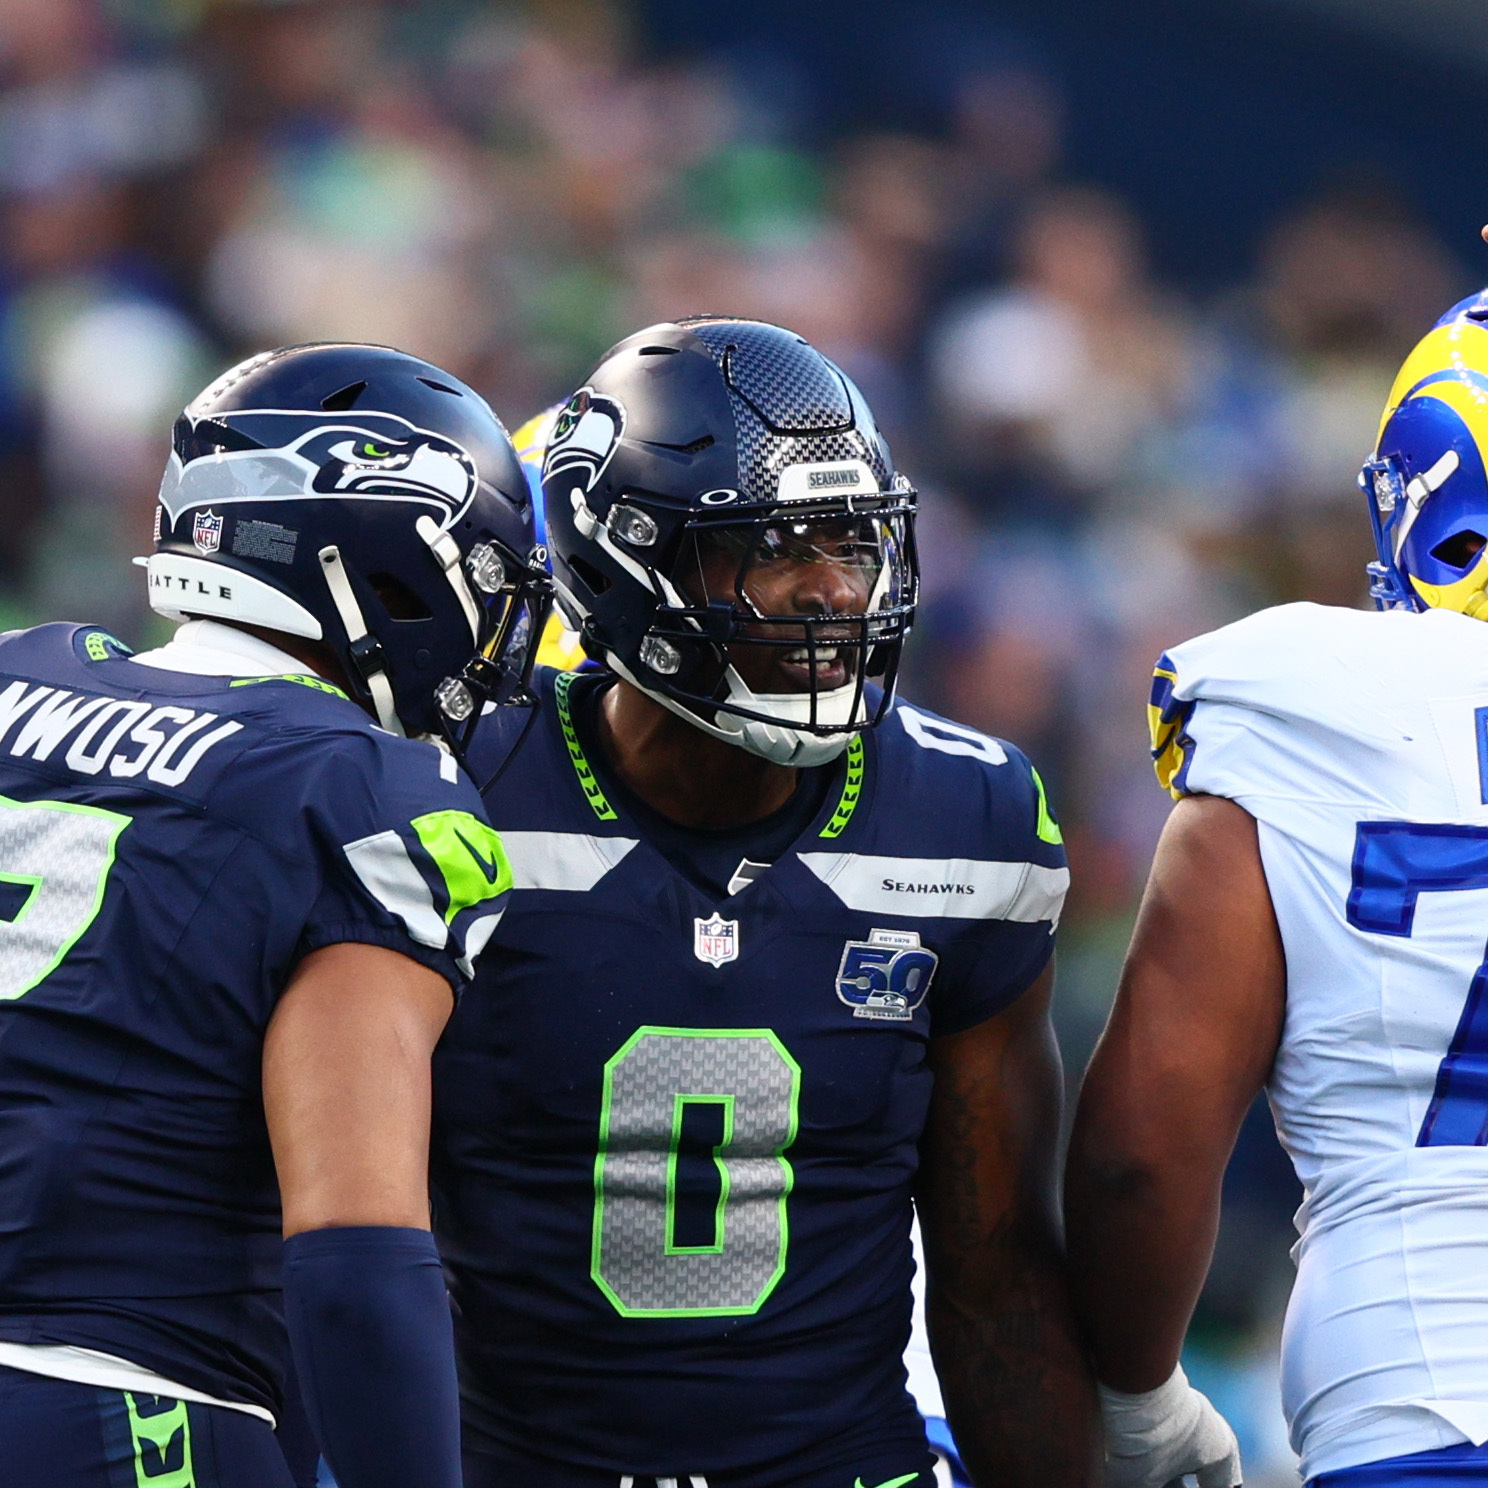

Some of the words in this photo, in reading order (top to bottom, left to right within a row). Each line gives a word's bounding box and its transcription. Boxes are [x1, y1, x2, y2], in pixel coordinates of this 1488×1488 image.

[809, 469, 860, 487] SEAHAWKS
[196, 528, 217, 548] NFL
[881, 878, 976, 895] SEAHAWKS
[703, 937, 731, 957] NFL
[838, 947, 938, 1006] 50
[591, 1025, 801, 1318] 0
